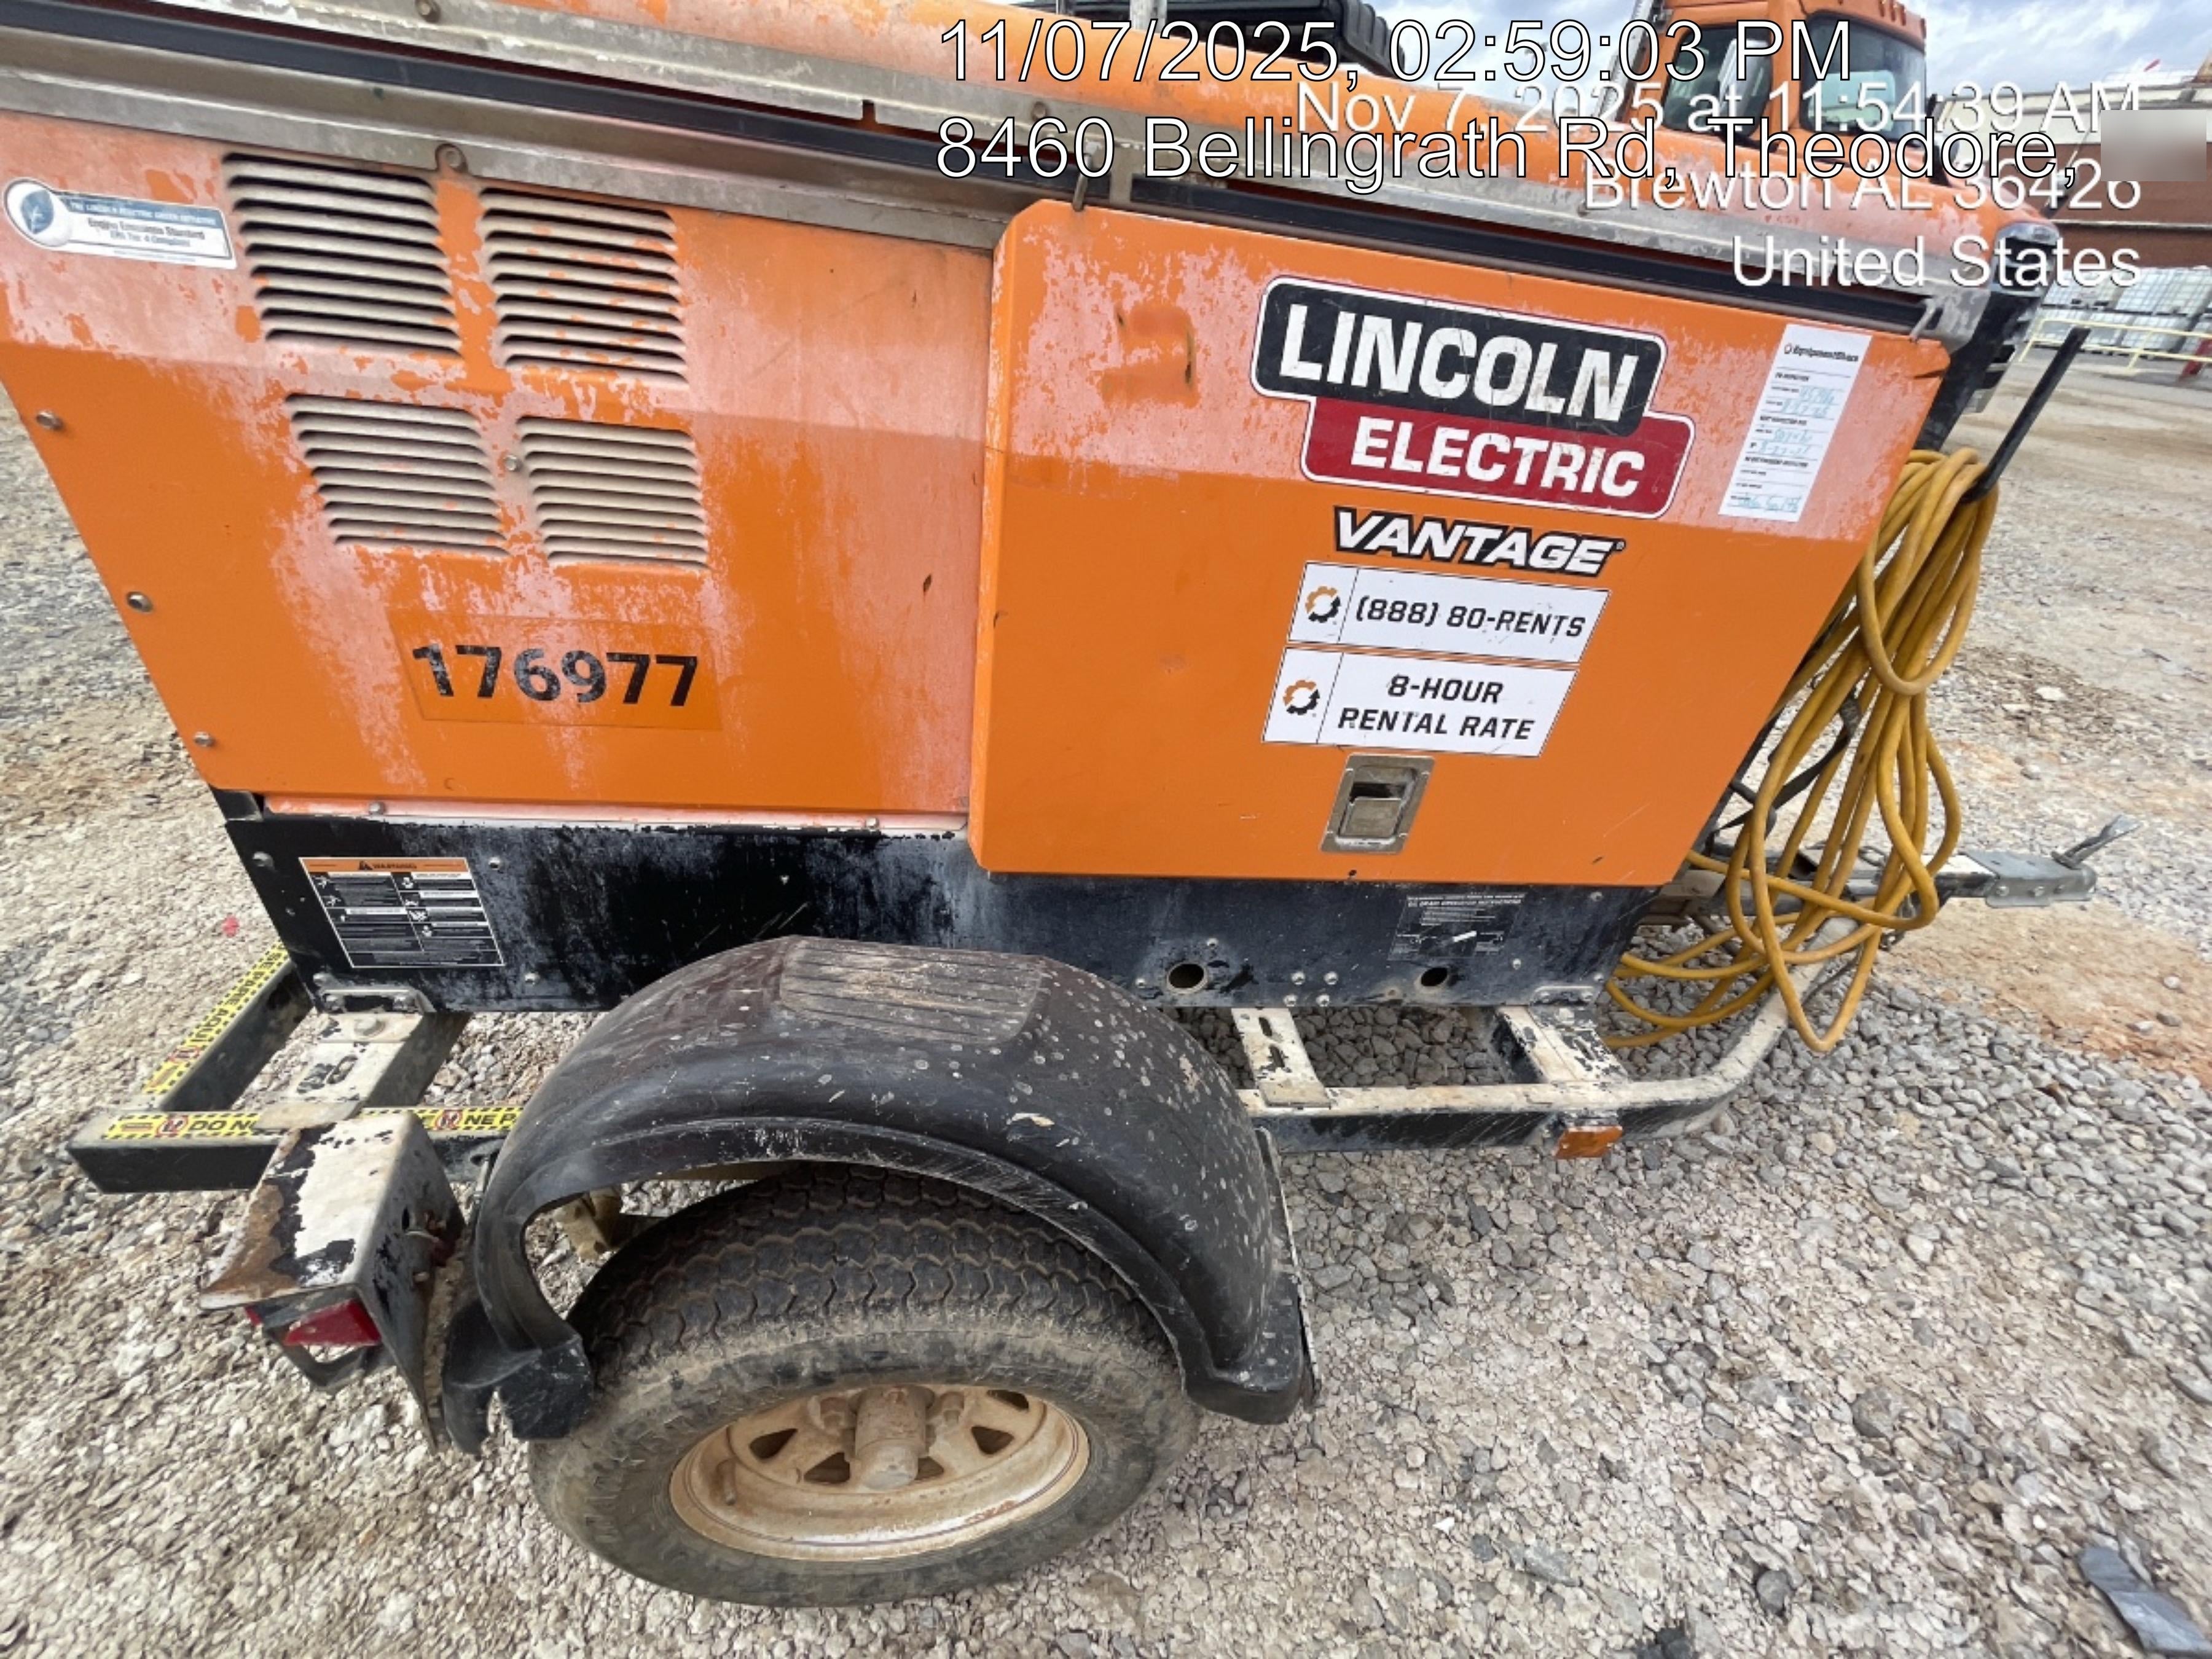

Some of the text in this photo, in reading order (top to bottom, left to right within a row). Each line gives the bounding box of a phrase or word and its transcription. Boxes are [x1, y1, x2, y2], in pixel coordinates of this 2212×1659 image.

[1279, 304, 1639, 423] LINCOLN
[1351, 417, 1645, 498] ELECTRIC
[1355, 596, 1586, 638] (888) 80-RENTS
[412, 643, 698, 707] 176977
[1387, 675, 1504, 704] 8-HOUR
[1338, 707, 1535, 740] RENTAL RATE
[188, 1120, 227, 1131] DO
[465, 1115, 494, 1124] NE
